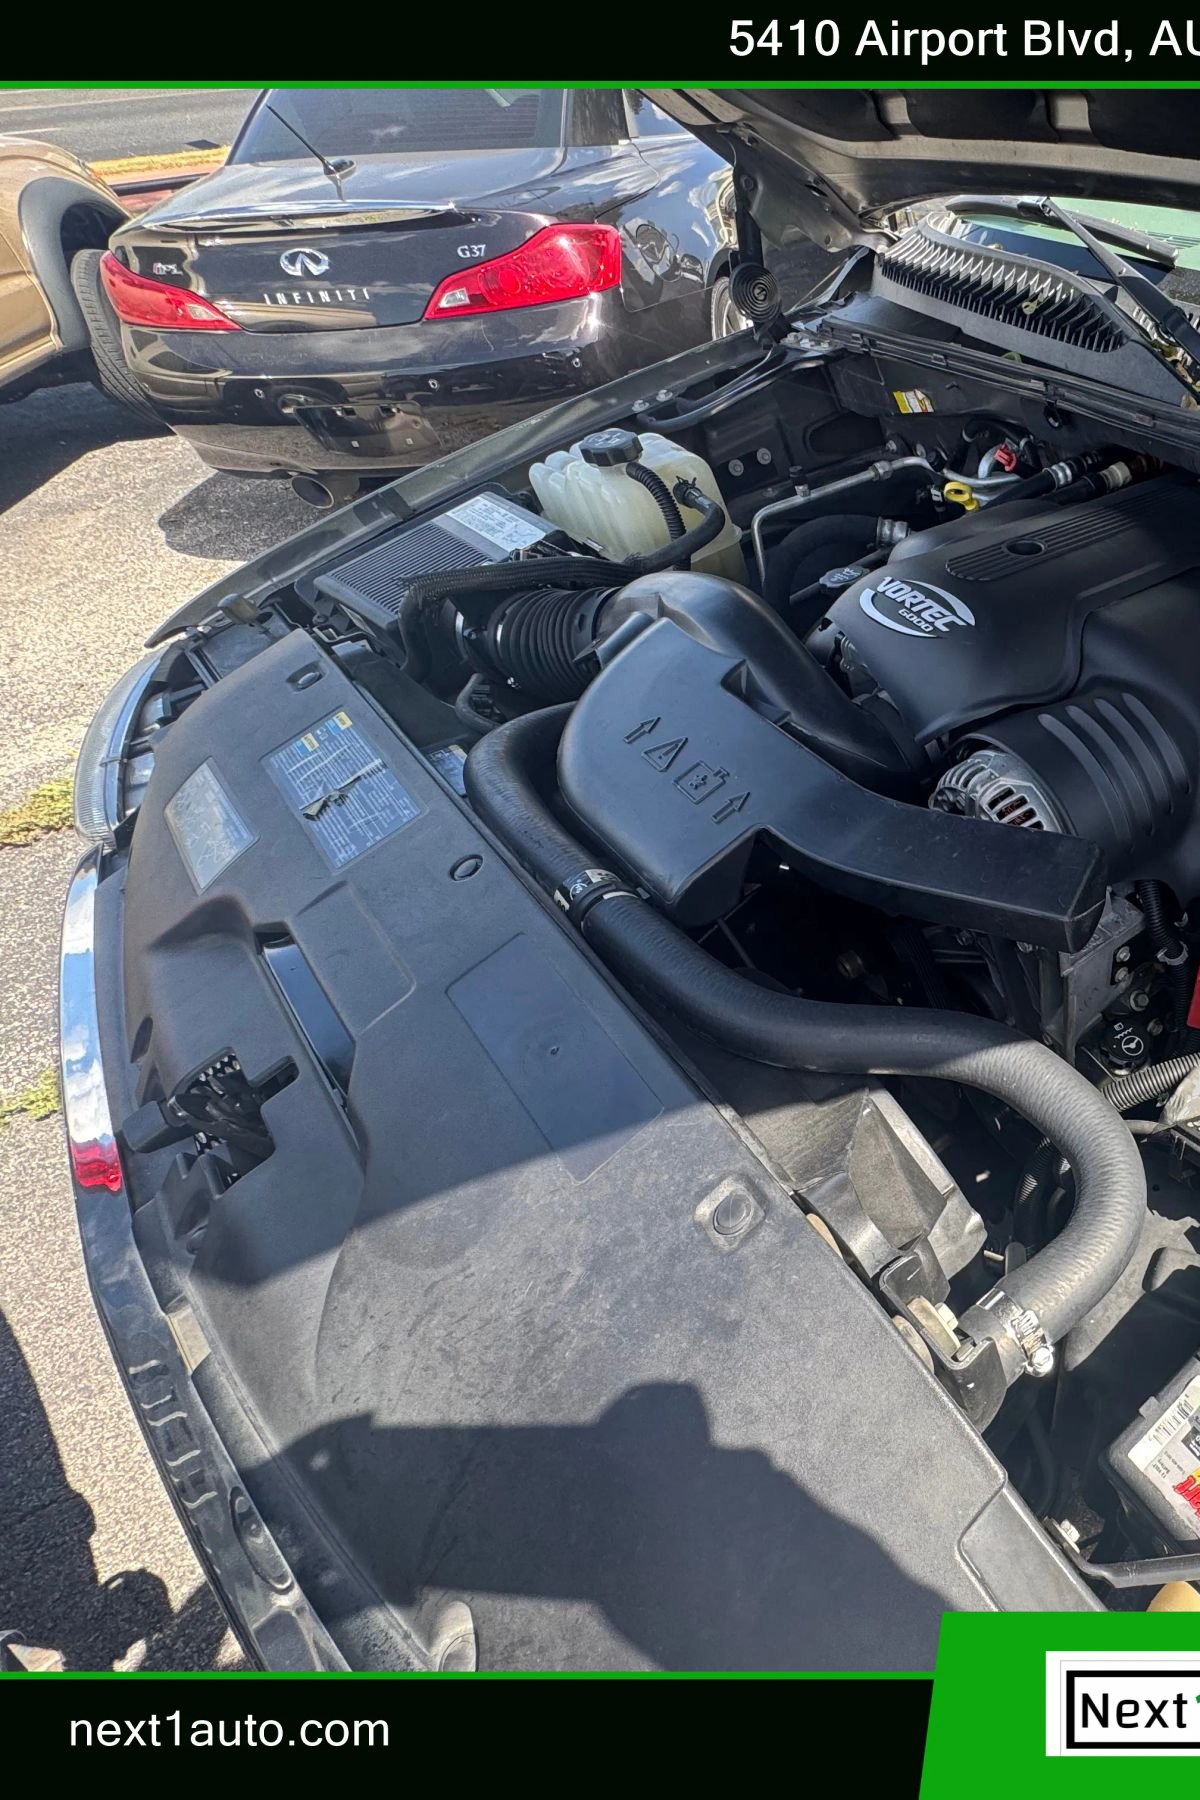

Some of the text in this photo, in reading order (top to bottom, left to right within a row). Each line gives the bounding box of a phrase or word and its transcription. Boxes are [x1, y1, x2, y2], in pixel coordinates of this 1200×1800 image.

[456, 244, 487, 259] G37
[262, 287, 372, 305] INFINITI
[876, 576, 968, 632] VORTEC
[897, 608, 935, 632] 6000
